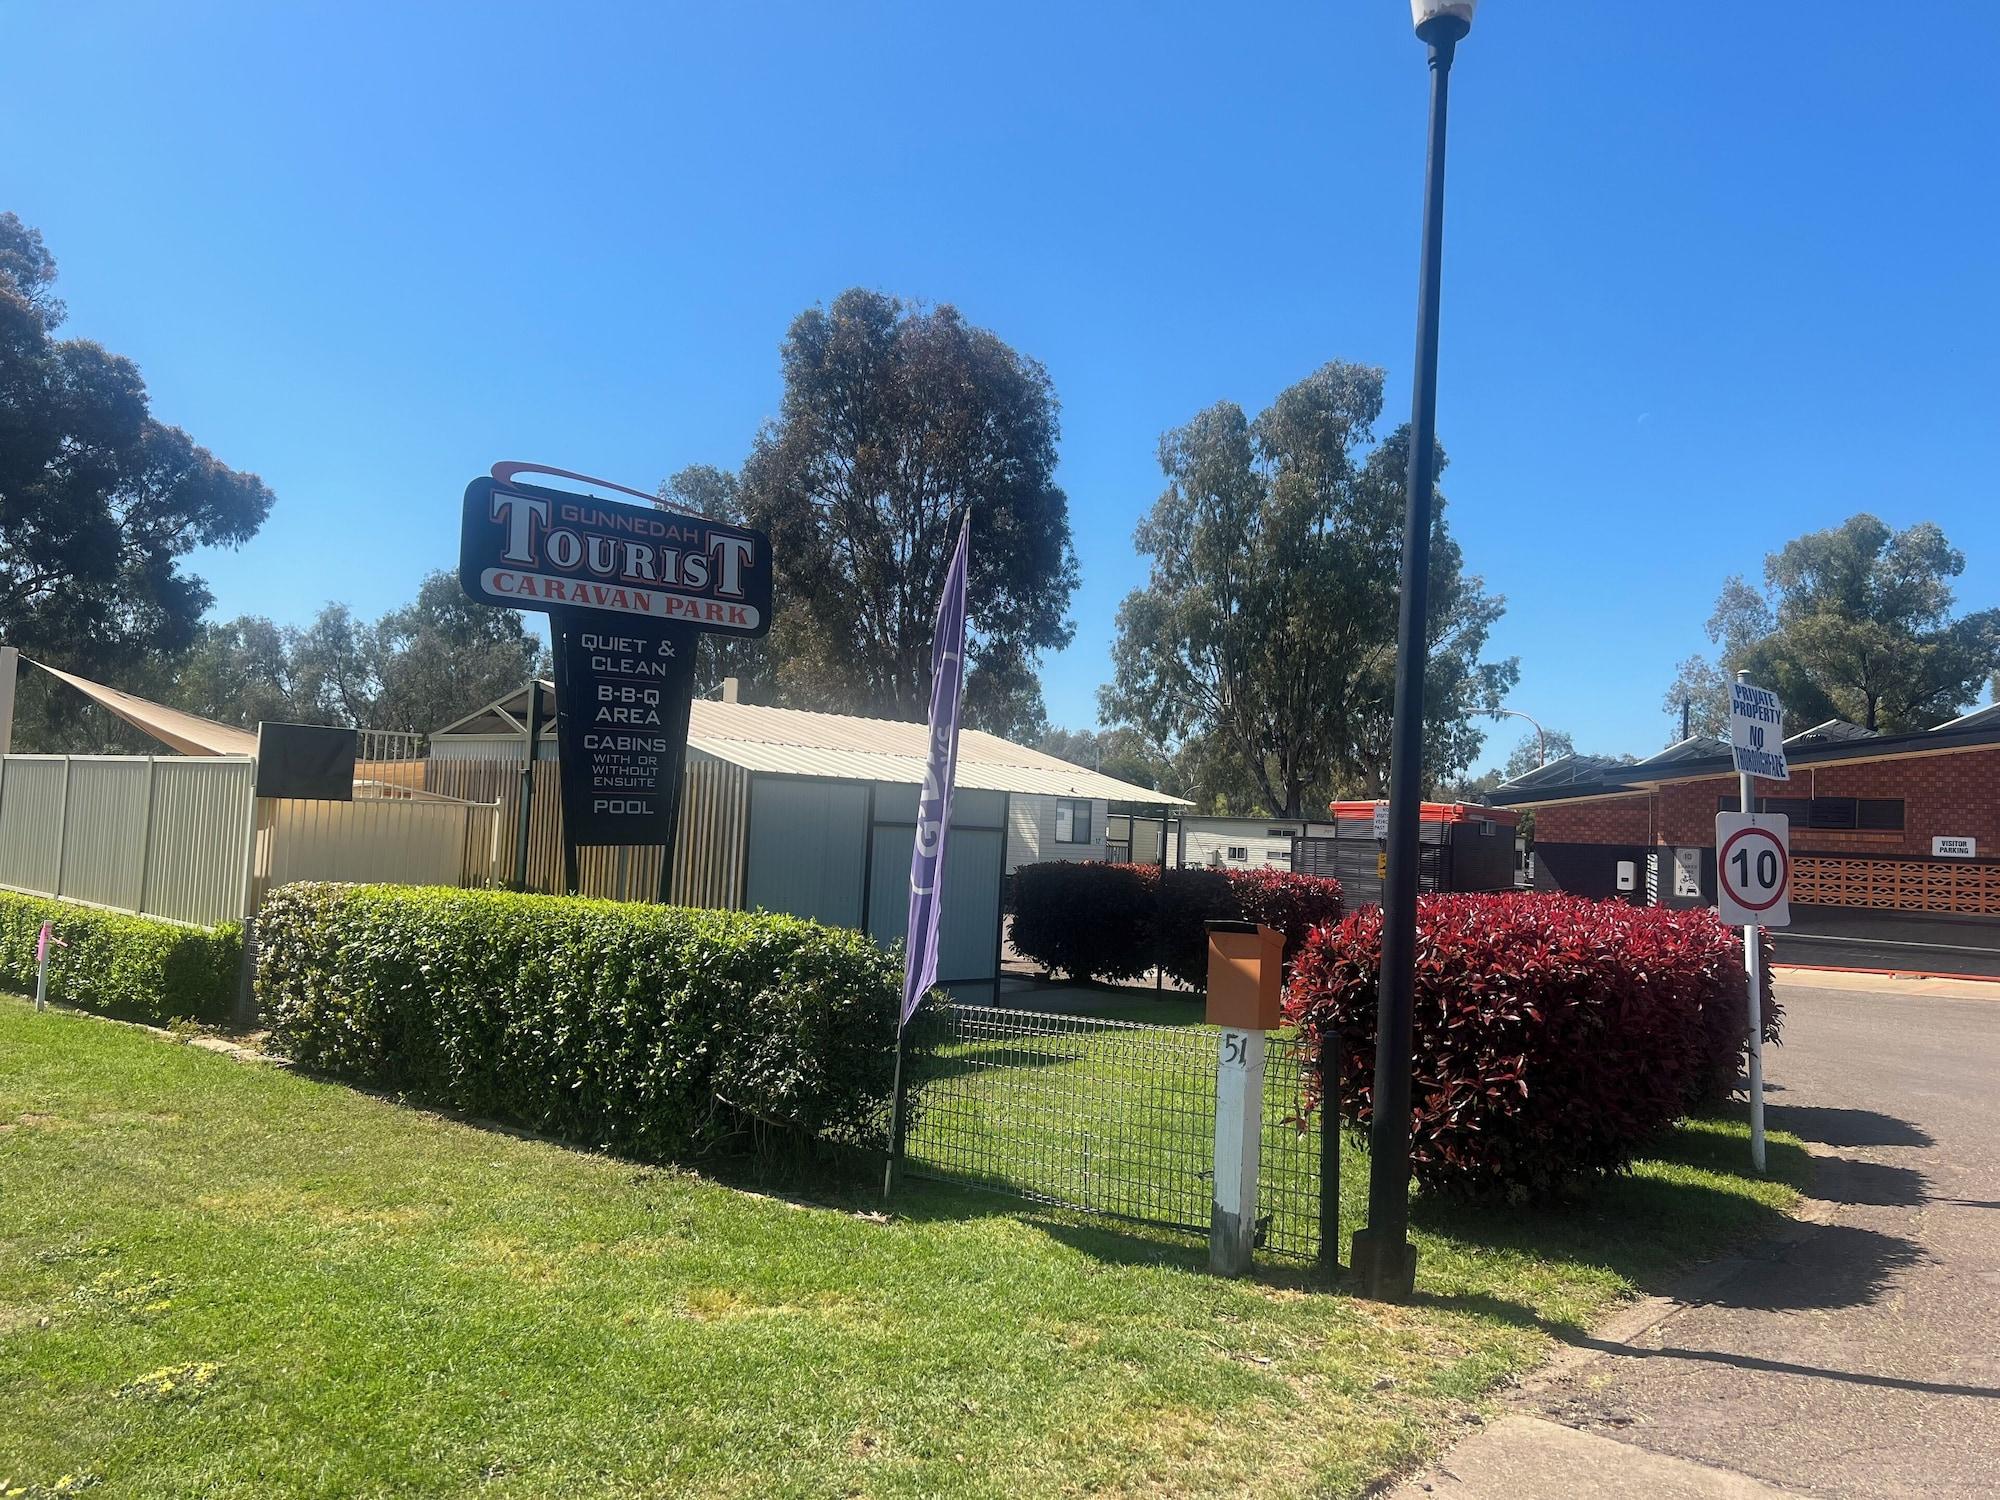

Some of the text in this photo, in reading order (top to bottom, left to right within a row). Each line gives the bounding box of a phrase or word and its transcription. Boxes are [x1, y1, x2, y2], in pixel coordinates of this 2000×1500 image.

[560, 504, 699, 545] GUNNEDAH
[491, 490, 754, 598] TOURIST
[492, 572, 748, 625] CARAVAN PARK
[581, 633, 676, 657] QUIET &
[591, 655, 666, 676] CLEAN
[597, 684, 660, 708] B-B-Q
[1734, 684, 1775, 708] PRIVATE
[595, 706, 661, 726] AREA
[1733, 699, 1781, 725] PROPERTY
[583, 734, 666, 753] CABINS
[1749, 725, 1764, 748] NO
[592, 764, 659, 776] WITHOUT
[593, 753, 657, 766] WITH OR
[593, 776, 656, 788] ENSUITE
[593, 799, 654, 815] POOL
[1939, 846, 1969, 854] PARKING
[1732, 848, 1777, 889] 10
[1225, 1033, 1248, 1065] 51
